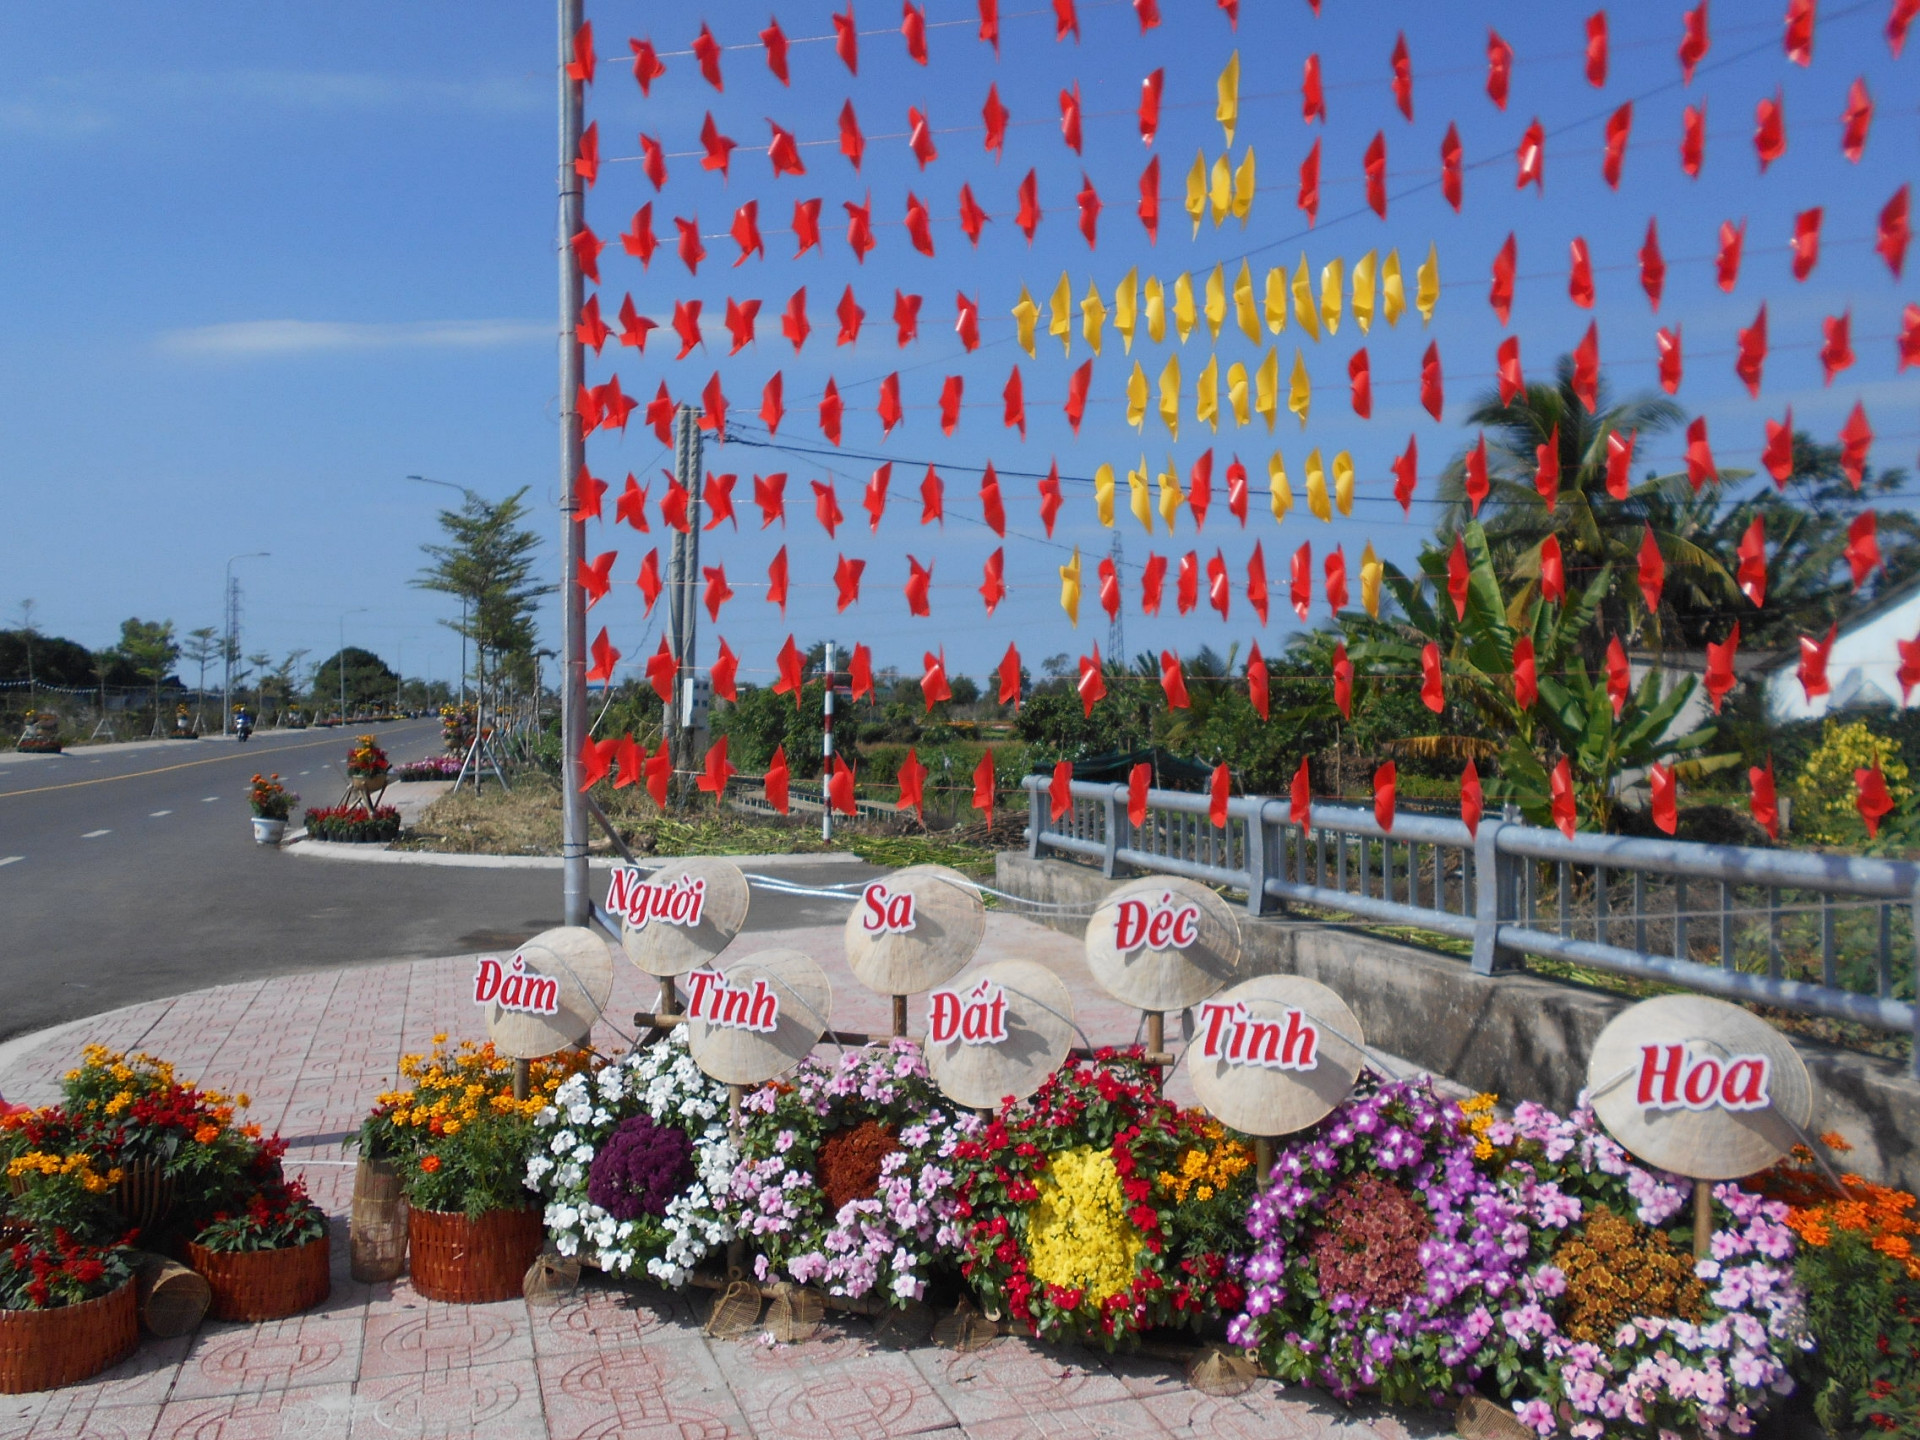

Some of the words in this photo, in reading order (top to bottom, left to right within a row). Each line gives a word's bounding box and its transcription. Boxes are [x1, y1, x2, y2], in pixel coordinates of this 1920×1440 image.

[606, 868, 704, 926] Người
[863, 884, 912, 930] Sa
[1113, 892, 1198, 951] Đéc
[475, 954, 556, 1011] Đắm
[688, 971, 778, 1028] Tình
[929, 979, 1006, 1042] Đất
[1201, 1002, 1317, 1066] Tình
[1637, 1044, 1766, 1105] Hoa
